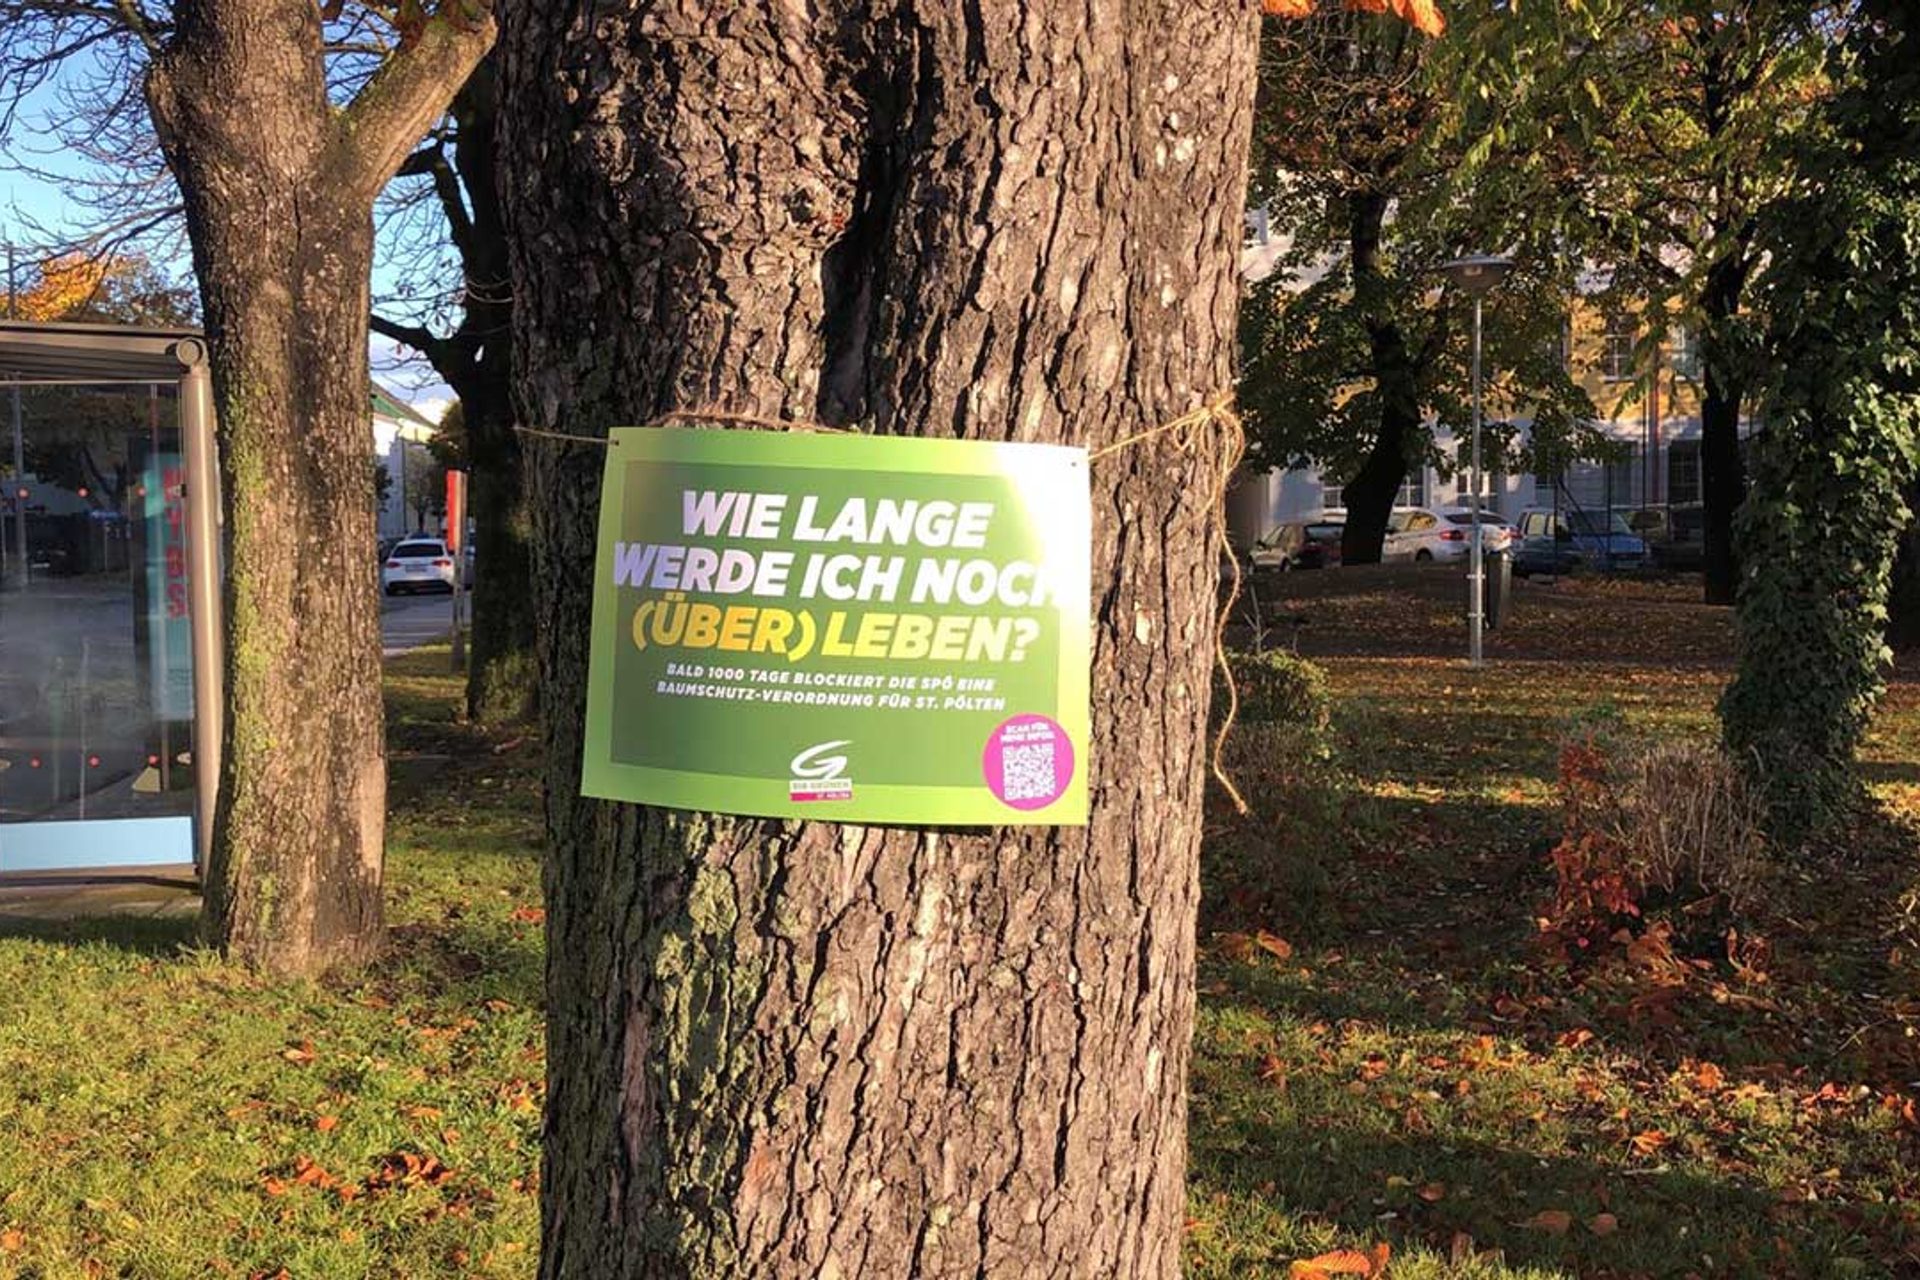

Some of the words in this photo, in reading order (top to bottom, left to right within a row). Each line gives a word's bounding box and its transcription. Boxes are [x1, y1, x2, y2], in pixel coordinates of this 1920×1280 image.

[682, 490, 788, 540] WIE
[792, 496, 994, 548] LANGE
[613, 541, 795, 597] WERDE
[800, 553, 905, 602] ICH
[632, 591, 817, 662] (ÜBER)
[821, 611, 1041, 663] LEBEN?
[656, 681, 874, 707] BAUMSCHUTZ-VERORDNUNG
[878, 693, 912, 709] FÜR
[914, 697, 939, 710] ST.
[944, 695, 1006, 711] PÖLTEN
[666, 663, 704, 678] BALD
[709, 667, 745, 681] 1000
[751, 670, 790, 684] TAGE
[793, 673, 885, 689] BLOCKIERT
[888, 676, 916, 690] DIE
[920, 675, 954, 690] SPÖ
[956, 678, 996, 692] EINE
